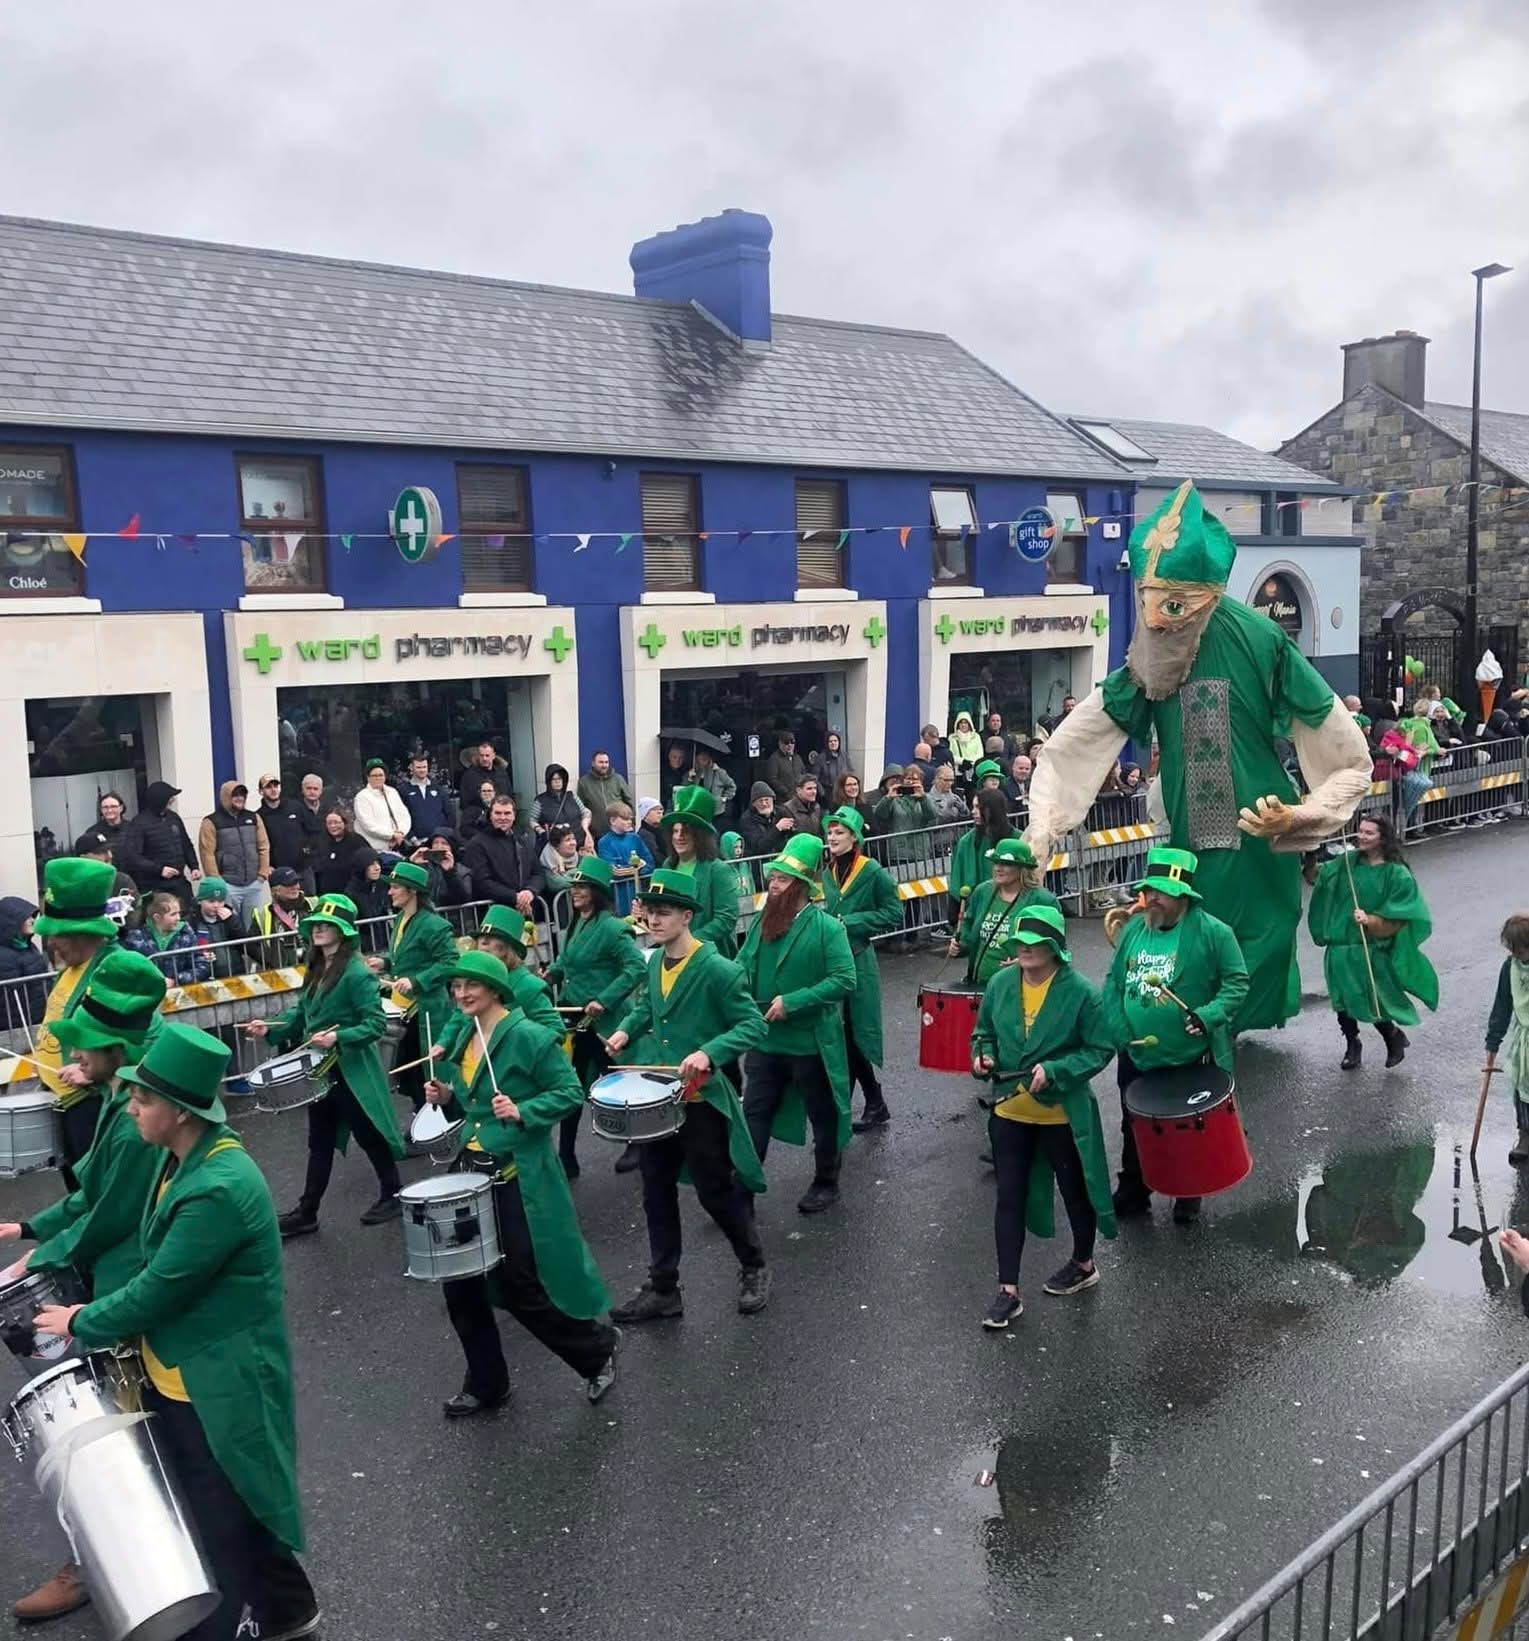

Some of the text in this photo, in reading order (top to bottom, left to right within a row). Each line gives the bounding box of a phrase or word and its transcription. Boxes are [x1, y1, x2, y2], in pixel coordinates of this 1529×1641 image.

[1019, 526, 1036, 541] gift
[1027, 539, 1050, 551] shop
[9, 576, 48, 589] Chloé
[960, 614, 1089, 638] ward pharmacy
[683, 623, 850, 649] ward pharmacy
[297, 633, 533, 664] ward pharmacy
[1137, 949, 1168, 965] Happy
[1138, 982, 1161, 997] Day
